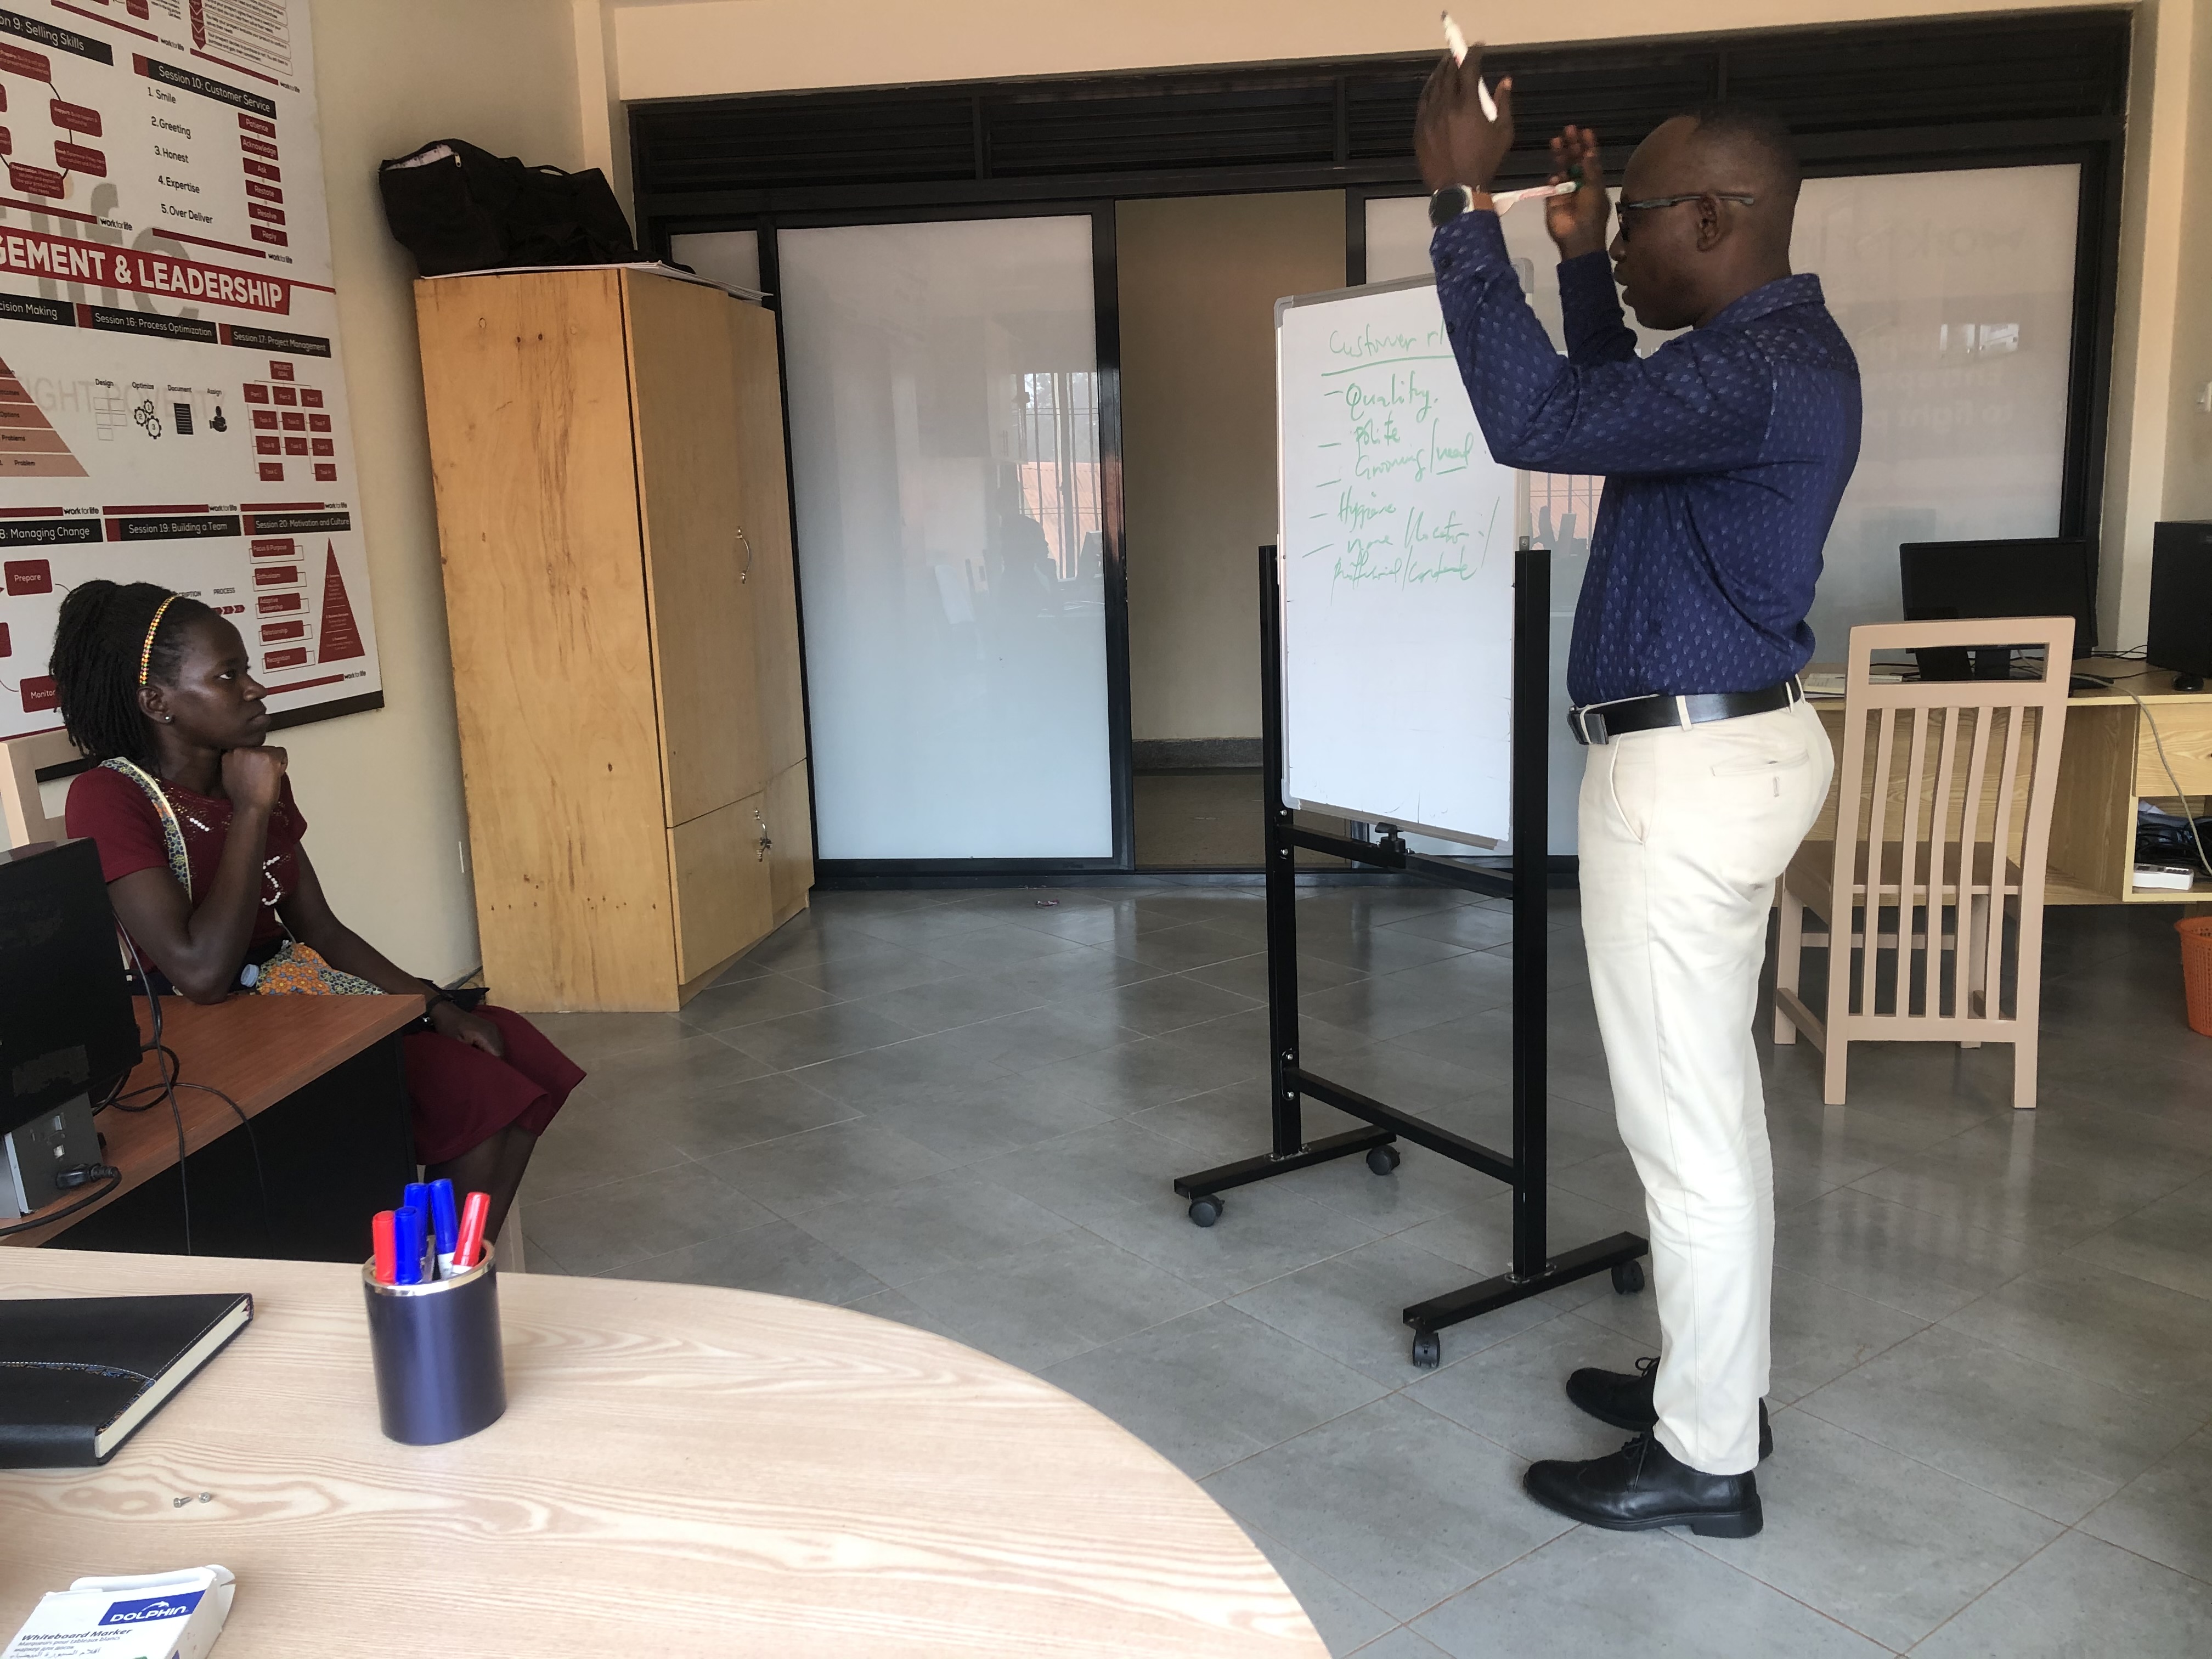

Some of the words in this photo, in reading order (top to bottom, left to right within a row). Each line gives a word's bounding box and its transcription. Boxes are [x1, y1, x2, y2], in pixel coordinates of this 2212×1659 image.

[26, 21, 58, 46] Selling
[60, 33, 84, 50] Skills
[159, 65, 190, 86] Session
[192, 77, 204, 91] 10:
[205, 82, 242, 103] Customer
[243, 95, 270, 112] Service
[156, 89, 176, 104] Smile
[246, 119, 269, 133] Patience
[242, 138, 276, 156] Acknowledge
[257, 165, 267, 174] Ask
[254, 185, 275, 198] Restate
[189, 210, 213, 224] Deliver
[257, 208, 277, 220] Resolve
[262, 230, 277, 242] Reply
[114, 255, 132, 284] &
[138, 258, 283, 308] LEADERSHIP
[25, 304, 58, 320] Making
[95, 313, 125, 326] Session
[126, 317, 137, 328] 16:
[139, 318, 167, 331] Process
[168, 323, 212, 337] Optimization
[233, 331, 258, 342] Session
[268, 336, 289, 348] Project
[290, 339, 327, 353] Management
[1329, 324, 1417, 358] Customer
[95, 379, 114, 388] Design
[132, 382, 154, 390] Optimize
[167, 385, 192, 393] Document
[207, 388, 222, 397] Assign
[129, 524, 158, 534] Session
[160, 523, 170, 533] 19:
[172, 523, 201, 534] Building
[208, 522, 228, 531] Team
[256, 521, 278, 529] Session
[290, 519, 319, 527] Motivation
[11, 528, 55, 541] Managing
[57, 527, 90, 539] Change
[14, 574, 41, 583] Prepare
[109, 1605, 187, 1622] DOLPHIN
[21, 1632, 91, 1641] Whiteboard
[90, 1628, 133, 1637] Marker
